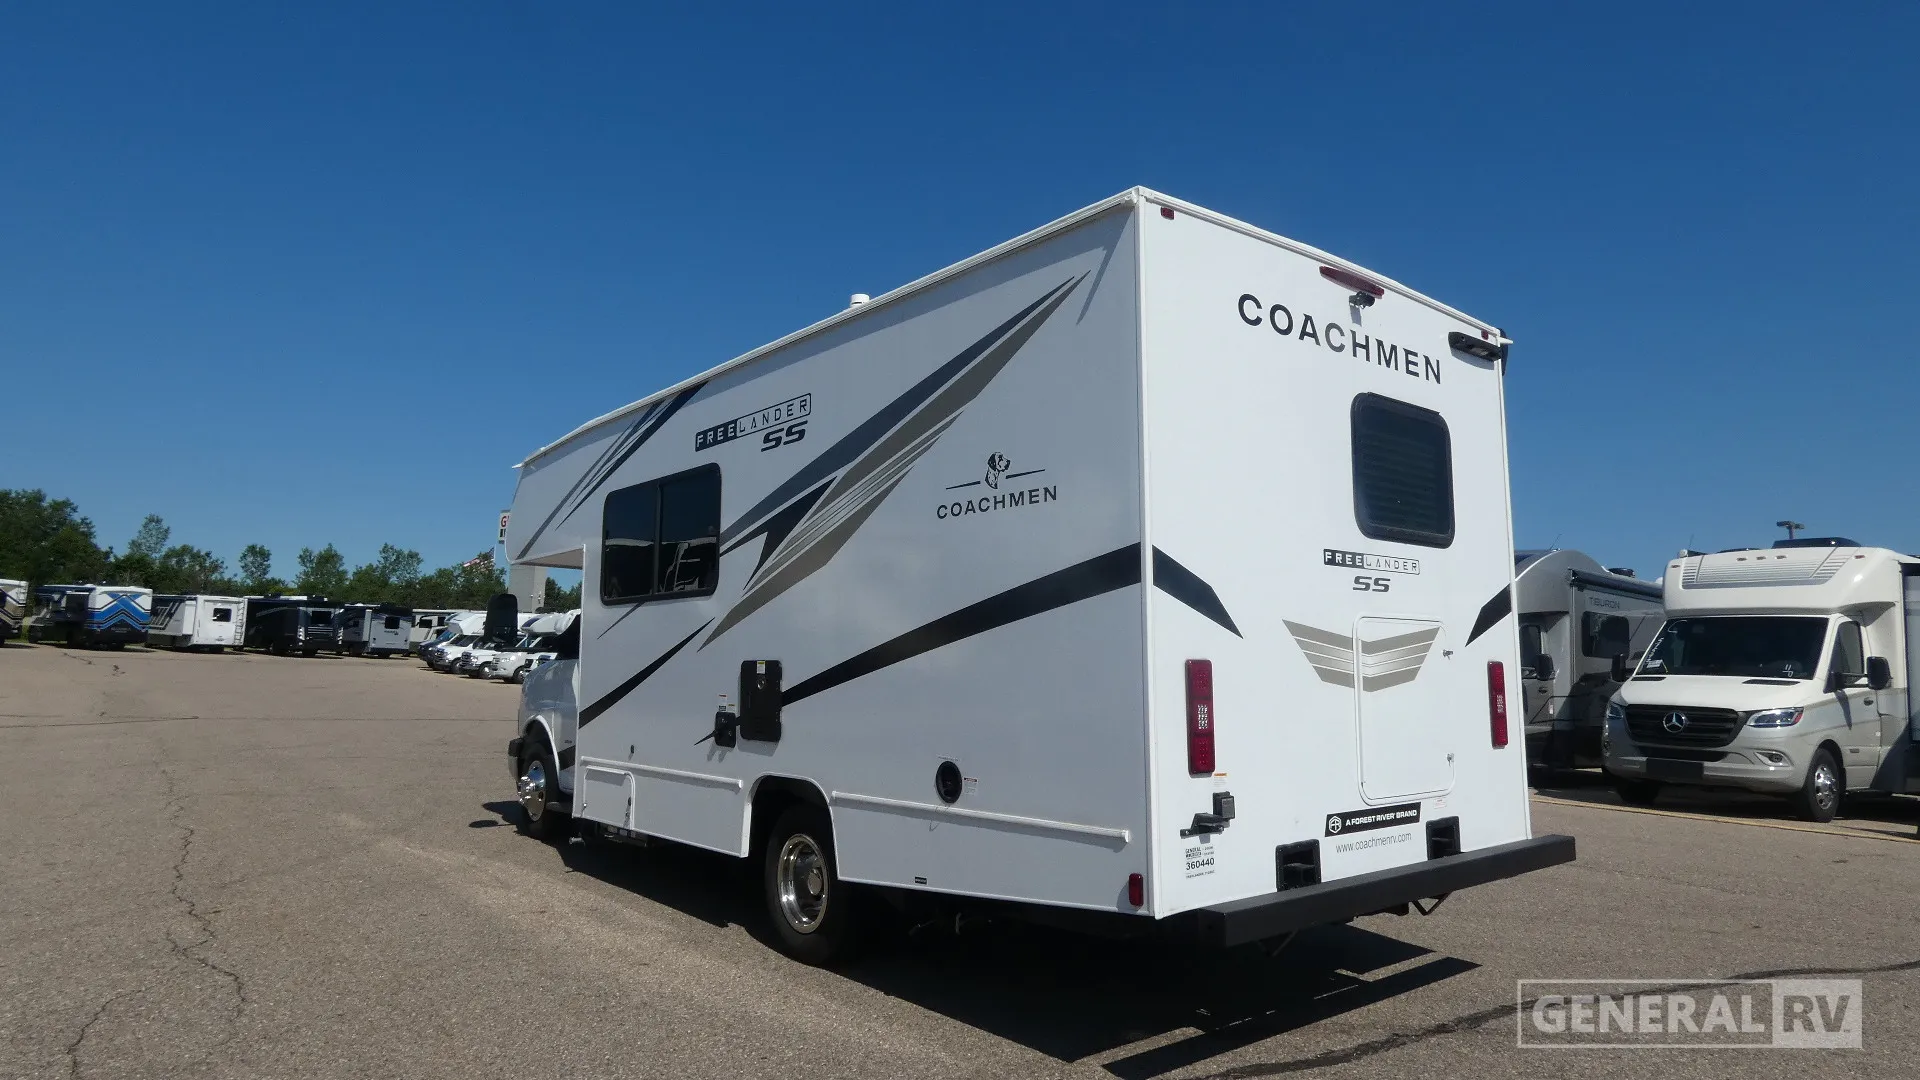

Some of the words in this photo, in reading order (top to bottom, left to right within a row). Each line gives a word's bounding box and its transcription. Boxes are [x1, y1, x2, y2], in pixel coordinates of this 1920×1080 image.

[1238, 293, 1441, 385] COACHMEN
[696, 398, 808, 448] FREELANDER
[760, 420, 808, 452] SS
[936, 485, 1057, 520] COACHMEN
[1325, 551, 1417, 572] FREELANDER
[1352, 575, 1391, 593] SS
[1589, 596, 1620, 609] TIBURON
[1351, 815, 1376, 826] FOREST
[1376, 812, 1395, 822] RIVER
[1395, 809, 1418, 819] BRAND
[1335, 832, 1412, 854] www.coachmenrv.com
[1185, 857, 1215, 871] 360440
